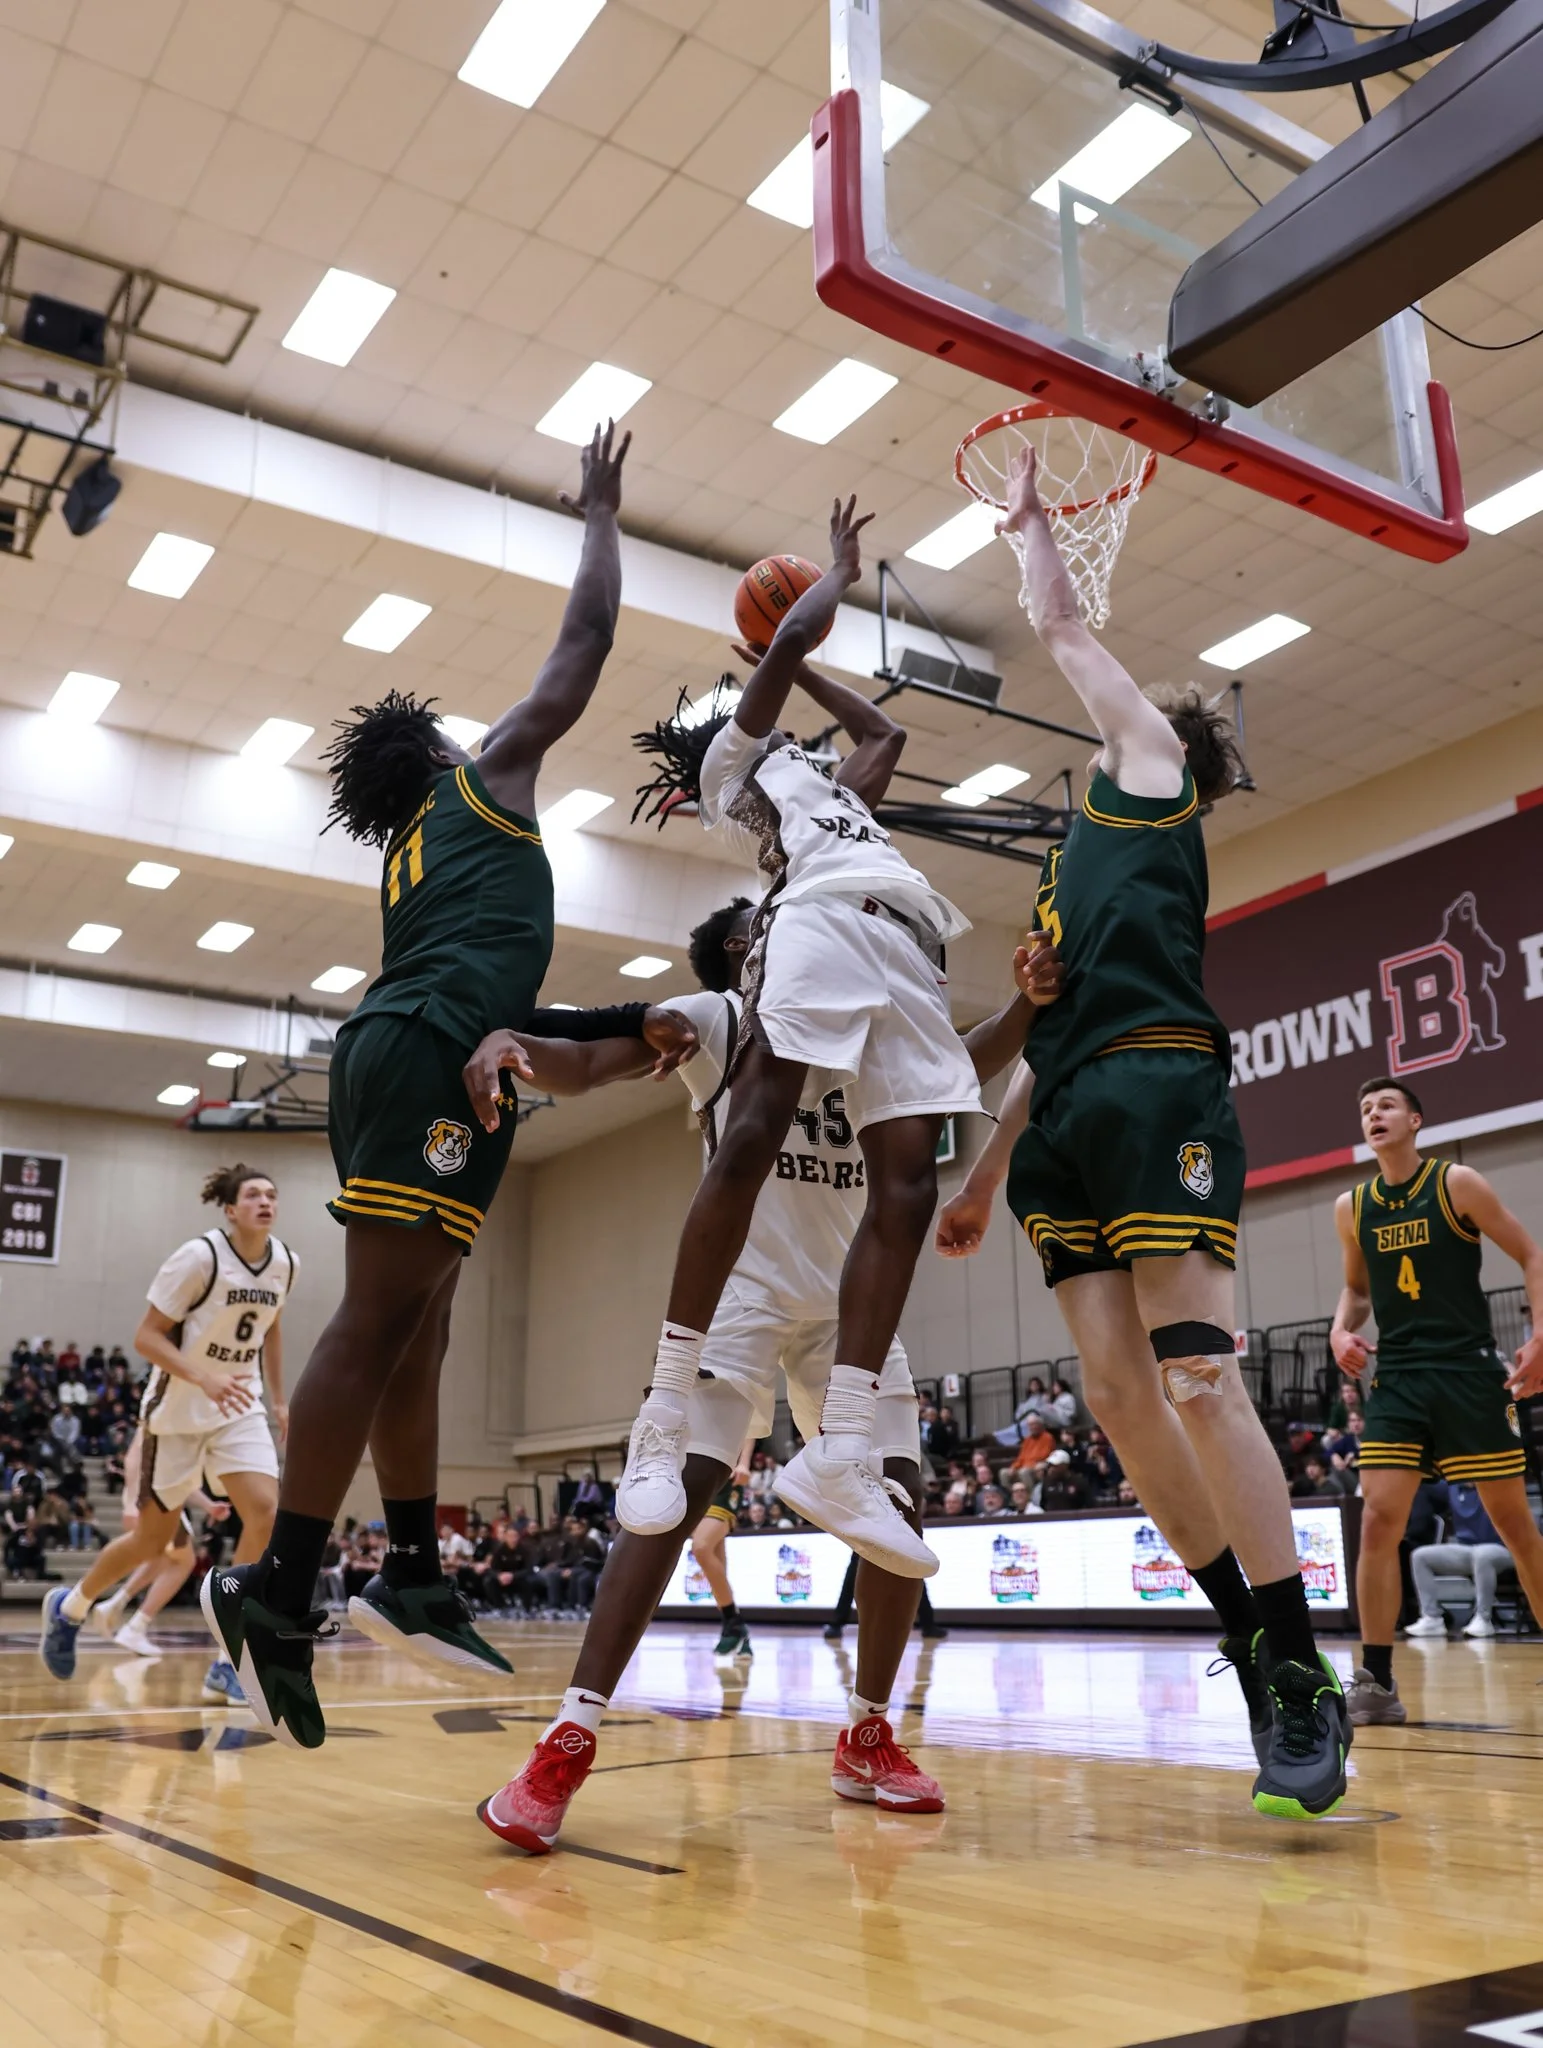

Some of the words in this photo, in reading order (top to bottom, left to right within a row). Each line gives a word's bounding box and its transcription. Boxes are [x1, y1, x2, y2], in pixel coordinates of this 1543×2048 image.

[1228, 988, 1373, 1088] ROWN
[1379, 940, 1473, 1078] B
[793, 1086, 855, 1149] 45
[12, 1201, 42, 1222] CBI
[1379, 1221, 1427, 1250] SIENA
[1397, 1254, 1421, 1301] 4
[226, 1288, 279, 1307] BROWN
[235, 1310, 259, 1343] 6
